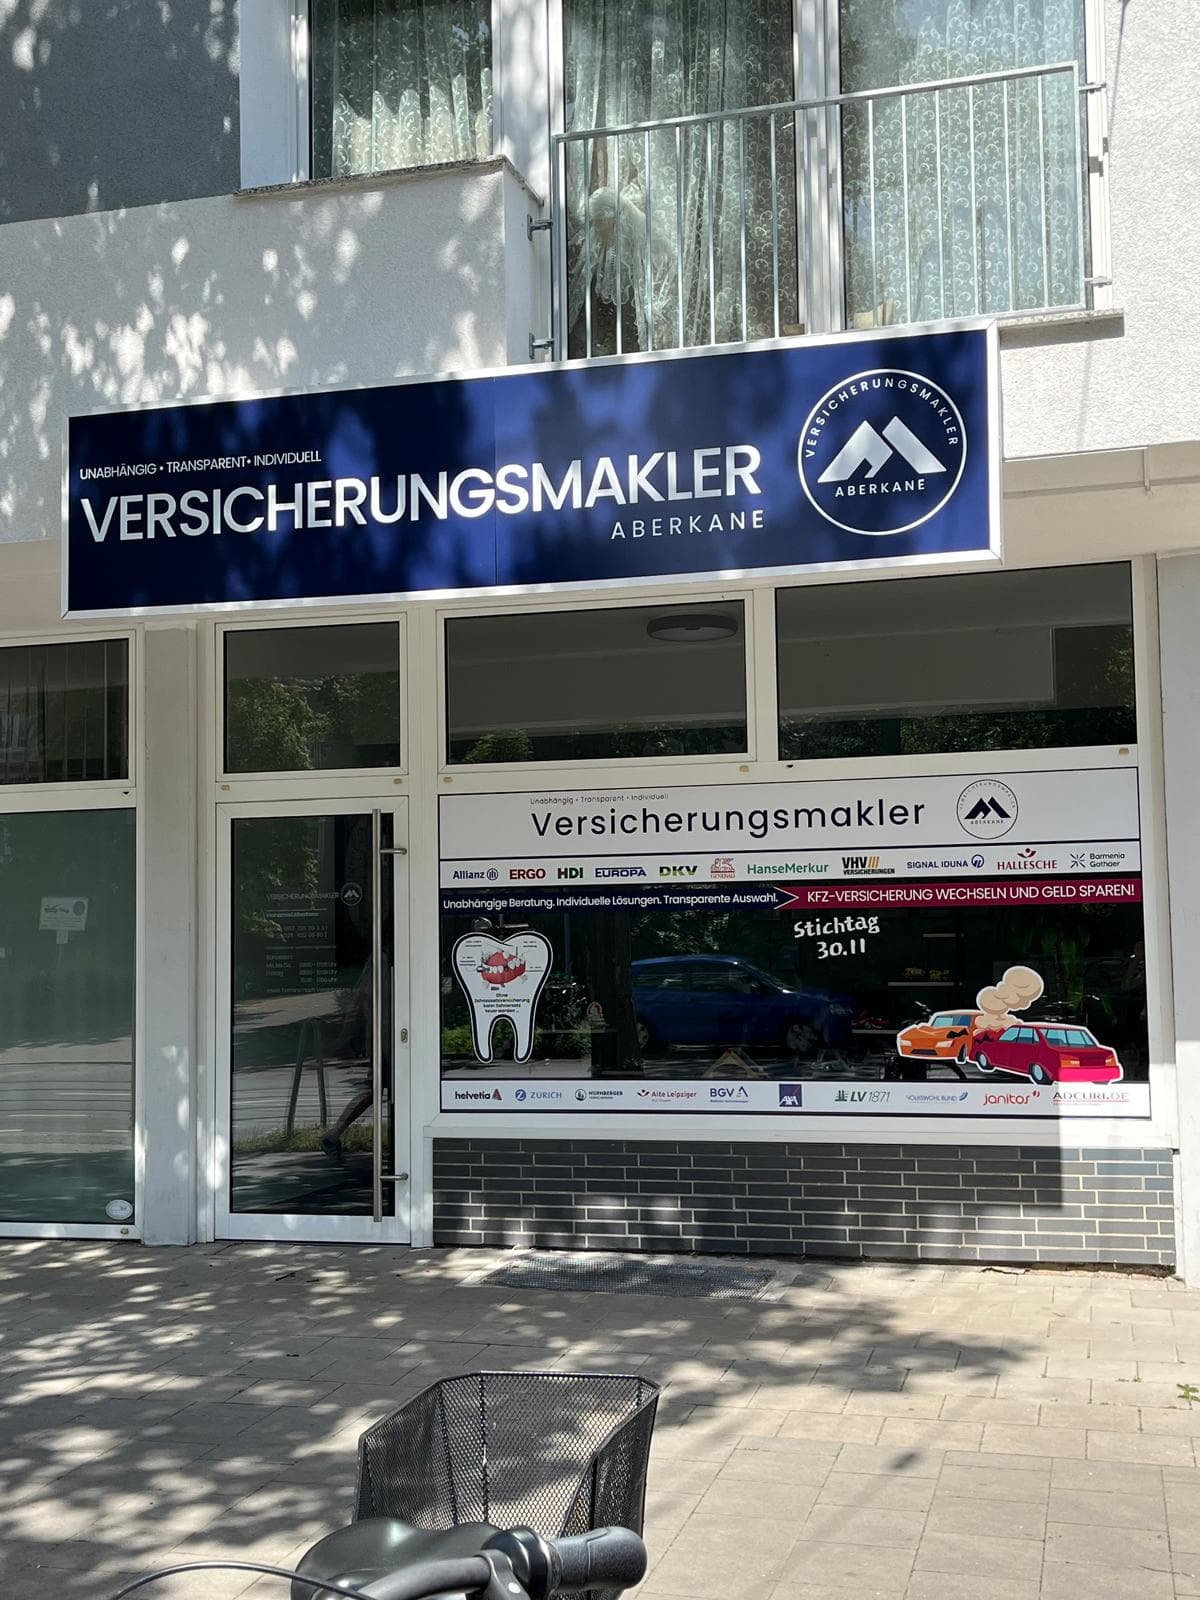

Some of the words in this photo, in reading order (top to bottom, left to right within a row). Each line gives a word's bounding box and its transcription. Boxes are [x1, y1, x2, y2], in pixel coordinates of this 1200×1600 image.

[805, 378, 959, 458] VERSICHERUNGSMAKLER
[80, 463, 157, 480] UNABHÄNGIG
[166, 456, 247, 473] TRANSPARENT
[253, 450, 322, 467] INDIVIDUELL
[81, 445, 762, 542] VERSICHERUNGSMAKLER
[835, 479, 926, 497] ABERKANE
[611, 510, 764, 539] ABERKANE
[581, 795, 624, 803] Transparent
[631, 793, 669, 801] Individuell
[531, 799, 925, 839] Versicherungsmakler
[1089, 852, 1125, 860] Barmenia
[747, 862, 829, 875] HanseMerkur
[842, 856, 868, 869] VHV
[907, 860, 939, 869] SIGNAL
[941, 859, 968, 868] IDUNA
[997, 859, 1057, 870] HALLESCHE
[1089, 860, 1121, 868] Gothaer
[452, 869, 485, 880] Allianz
[509, 868, 547, 880] ERGO
[557, 867, 584, 879] HDI
[595, 866, 647, 878] EUROPA
[659, 865, 698, 877] DKV
[843, 868, 896, 876] VERSICHERUNGEN
[807, 888, 933, 902] KFZ-VERSICHERUNG
[936, 887, 1007, 900] WECHSELN
[1009, 886, 1039, 899] UND
[1041, 885, 1076, 898] GELD
[1079, 884, 1135, 897] SPAREN!
[443, 898, 507, 910] Unabhängige
[509, 897, 555, 909] Beratung.
[557, 896, 611, 907] Individuelle
[612, 896, 662, 908] Lösungen.
[664, 894, 731, 906] Transparente
[732, 893, 779, 903] Auswahl.
[793, 916, 880, 938] Stichtag
[816, 938, 866, 959] 30.11
[455, 1090, 491, 1100] helvetia
[530, 1091, 562, 1099] ZURICH
[651, 1090, 666, 1098] Alte
[667, 1090, 697, 1099] Leipziger
[710, 1087, 735, 1098] BGV
[850, 1090, 868, 1102] LV
[868, 1090, 891, 1102] 1871
[779, 1095, 799, 1105] AXA
[983, 1092, 1029, 1106] janitos
